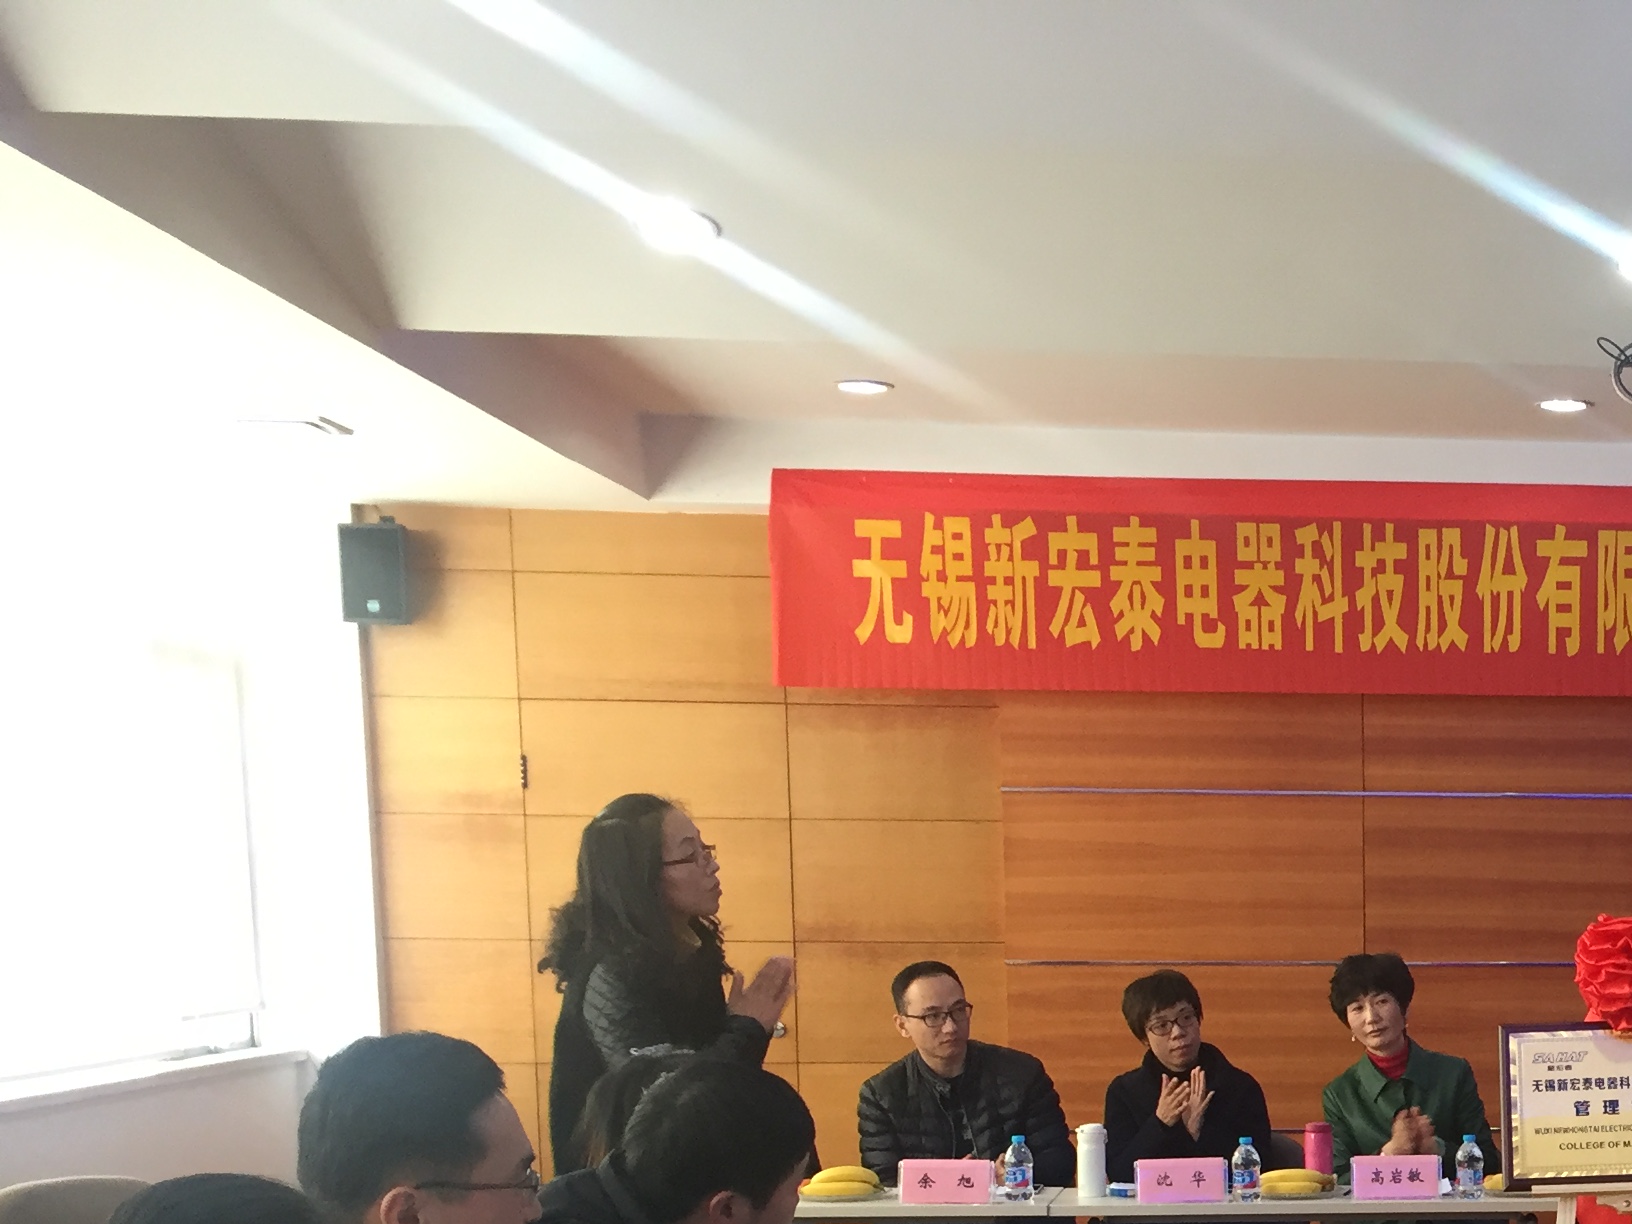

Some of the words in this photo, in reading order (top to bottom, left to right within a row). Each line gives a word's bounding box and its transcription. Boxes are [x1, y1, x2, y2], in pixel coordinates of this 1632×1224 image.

[1559, 1141, 1605, 1151] COLLEGE
[1608, 1140, 1621, 1149] OF
[917, 1172, 975, 1189] 余旭
[1156, 1170, 1207, 1189] 沈华
[1371, 1168, 1425, 1185] 高岩敏
